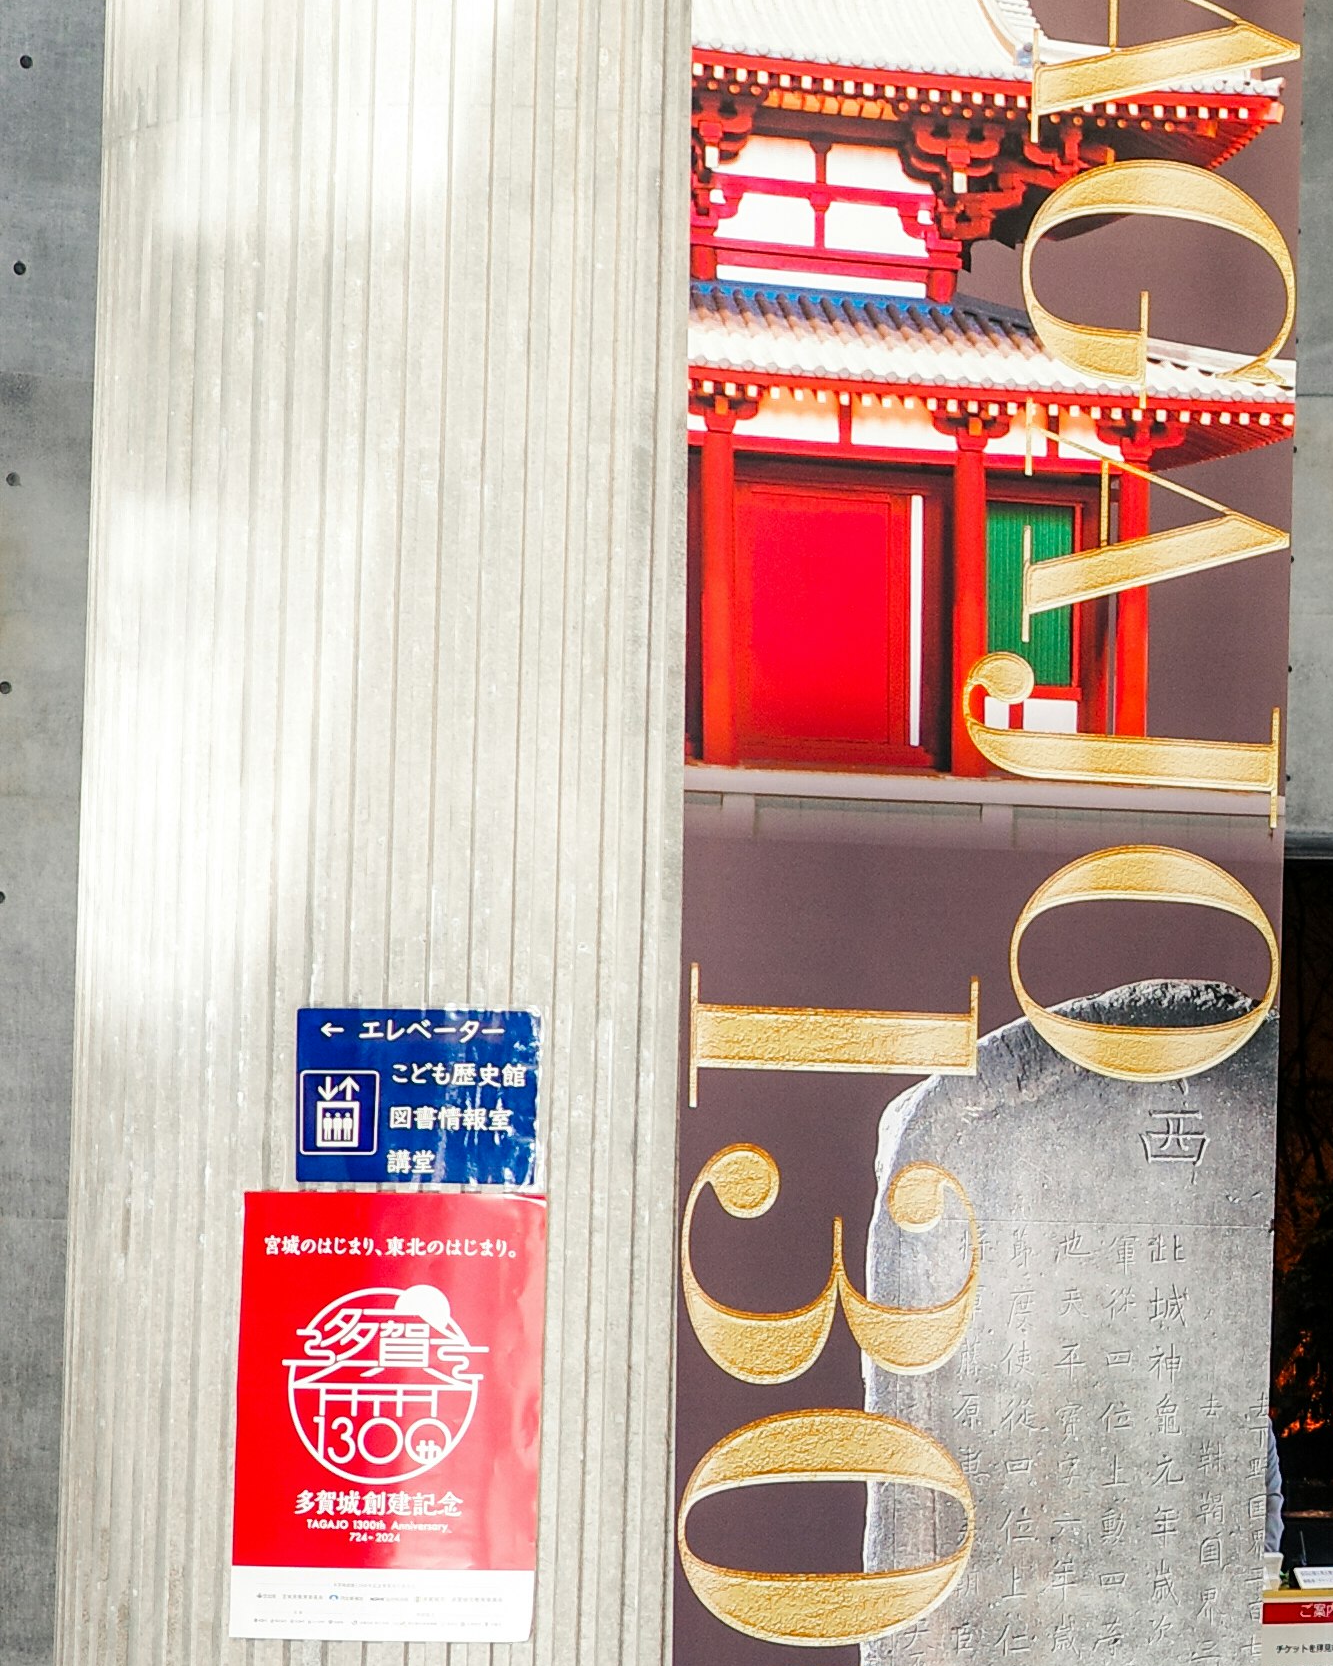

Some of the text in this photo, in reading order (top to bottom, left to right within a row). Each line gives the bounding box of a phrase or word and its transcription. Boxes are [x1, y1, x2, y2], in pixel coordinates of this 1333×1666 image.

[358, 1019, 505, 1043] エレベーター
[391, 1062, 527, 1088] こども歴史館
[389, 1106, 515, 1132] 図書情報室
[386, 1149, 436, 1174] 講堂
[263, 1234, 517, 1259] 宮城のはじまり、東北のはじまり。
[294, 1489, 464, 1517] 多賀城創建記念
[306, 1519, 349, 1530] TAGAJO
[352, 1519, 386, 1531] 1300th
